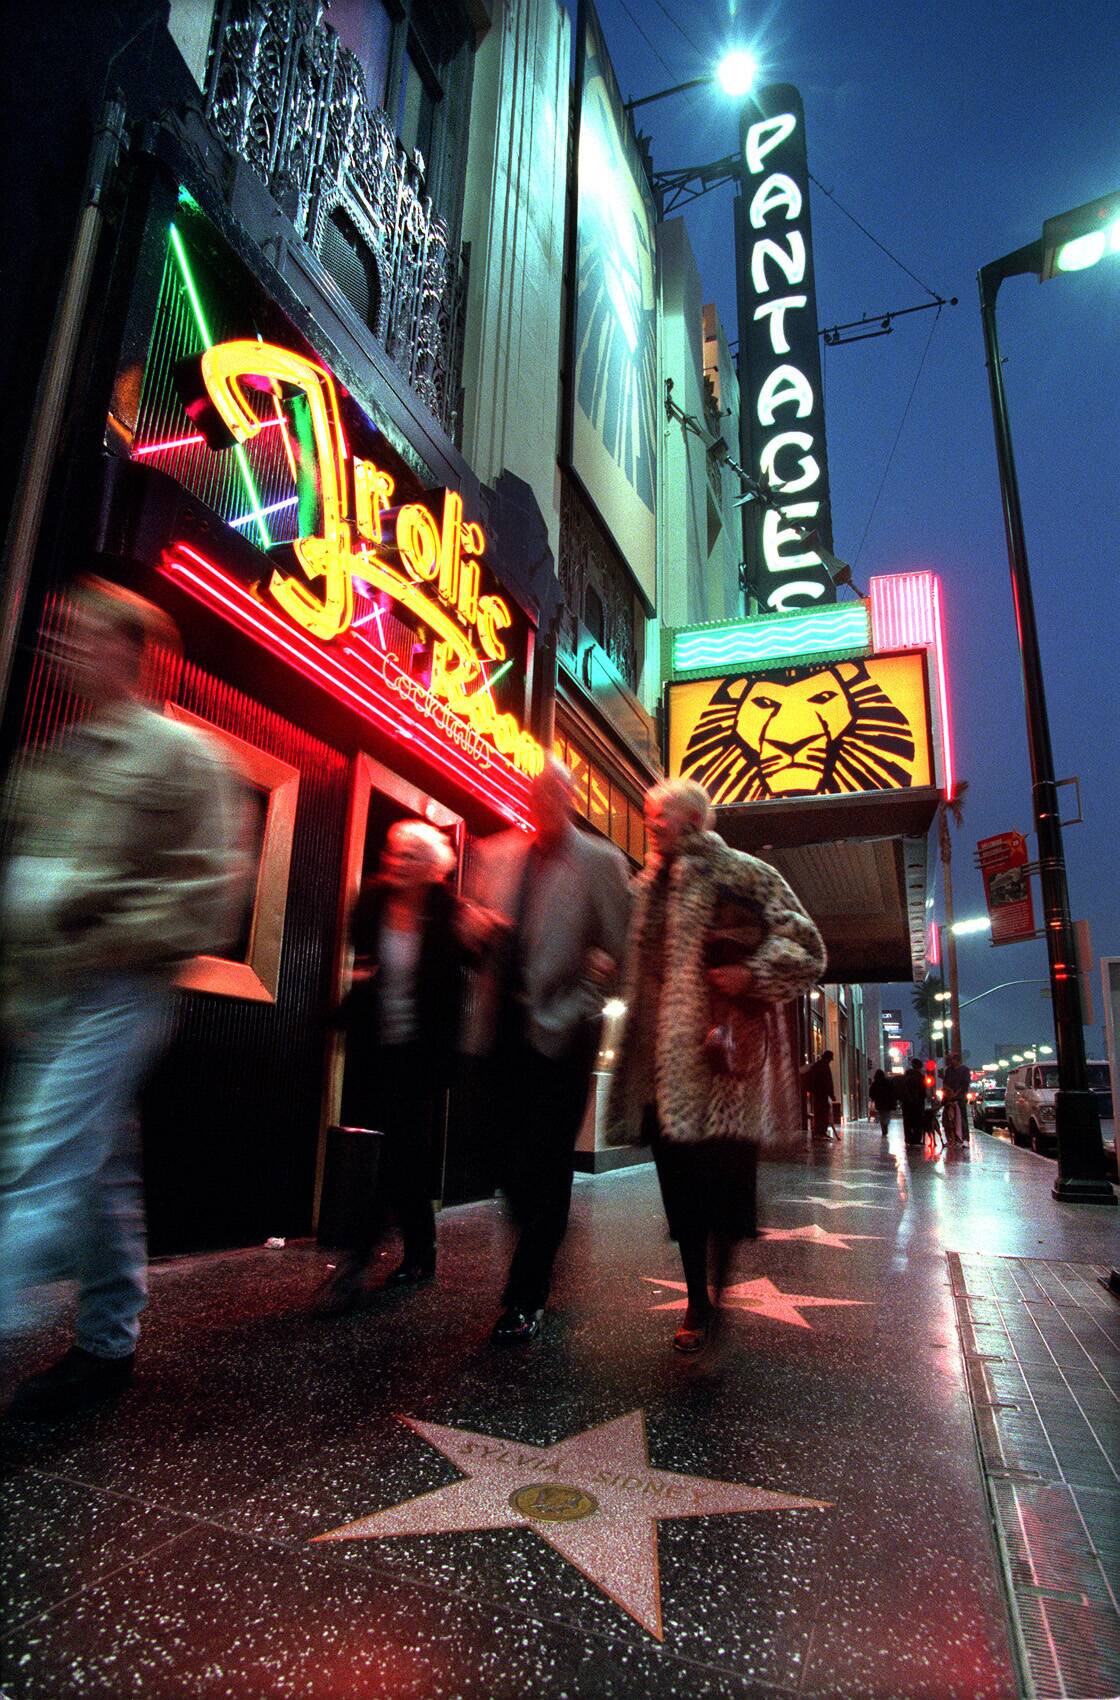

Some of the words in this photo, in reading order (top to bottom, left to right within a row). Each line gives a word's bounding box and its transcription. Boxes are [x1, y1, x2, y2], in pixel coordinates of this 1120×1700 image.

[202, 340, 511, 661] Frolic
[383, 653, 491, 768] Cocktails
[431, 641, 544, 778] Room
[459, 1441, 562, 1474] SYLVIA
[591, 1470, 709, 1504] SIDNEY
